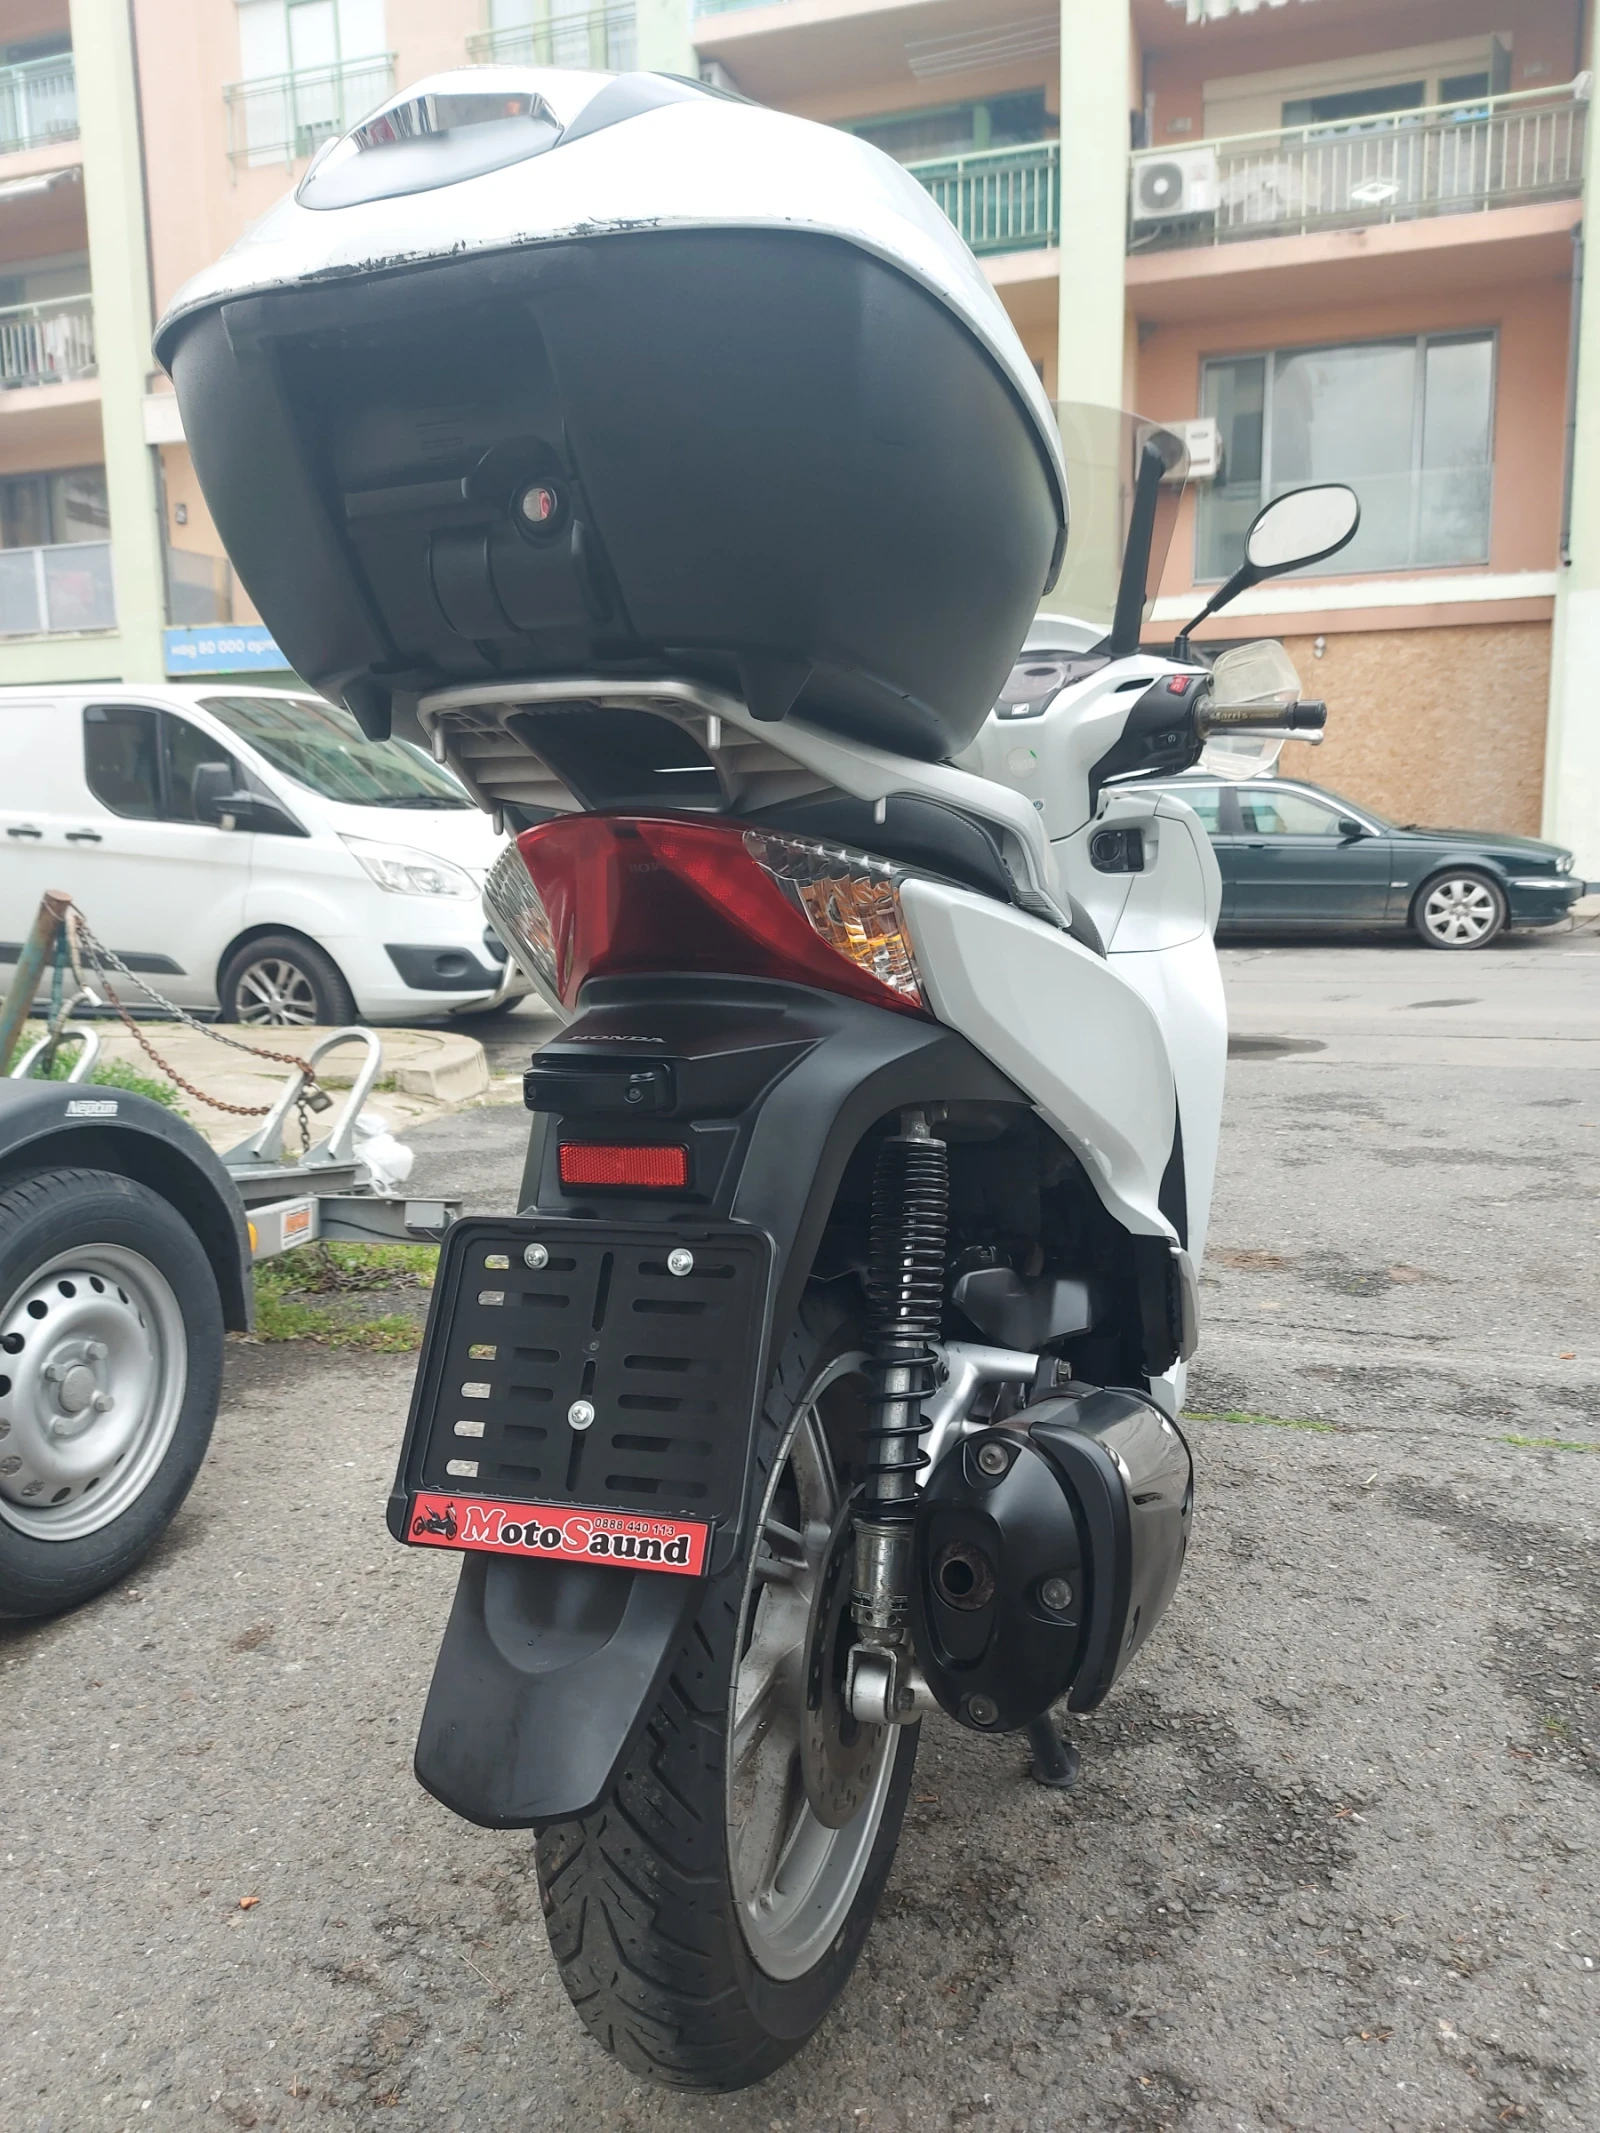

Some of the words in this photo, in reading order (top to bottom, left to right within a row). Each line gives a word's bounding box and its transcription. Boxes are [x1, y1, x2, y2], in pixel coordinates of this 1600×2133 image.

[567, 1035, 666, 1043] HONDA
[594, 1518, 623, 1530] 0888
[626, 1521, 649, 1533] 440
[652, 1524, 675, 1536] 113
[461, 1506, 690, 1567] MotoSaund
